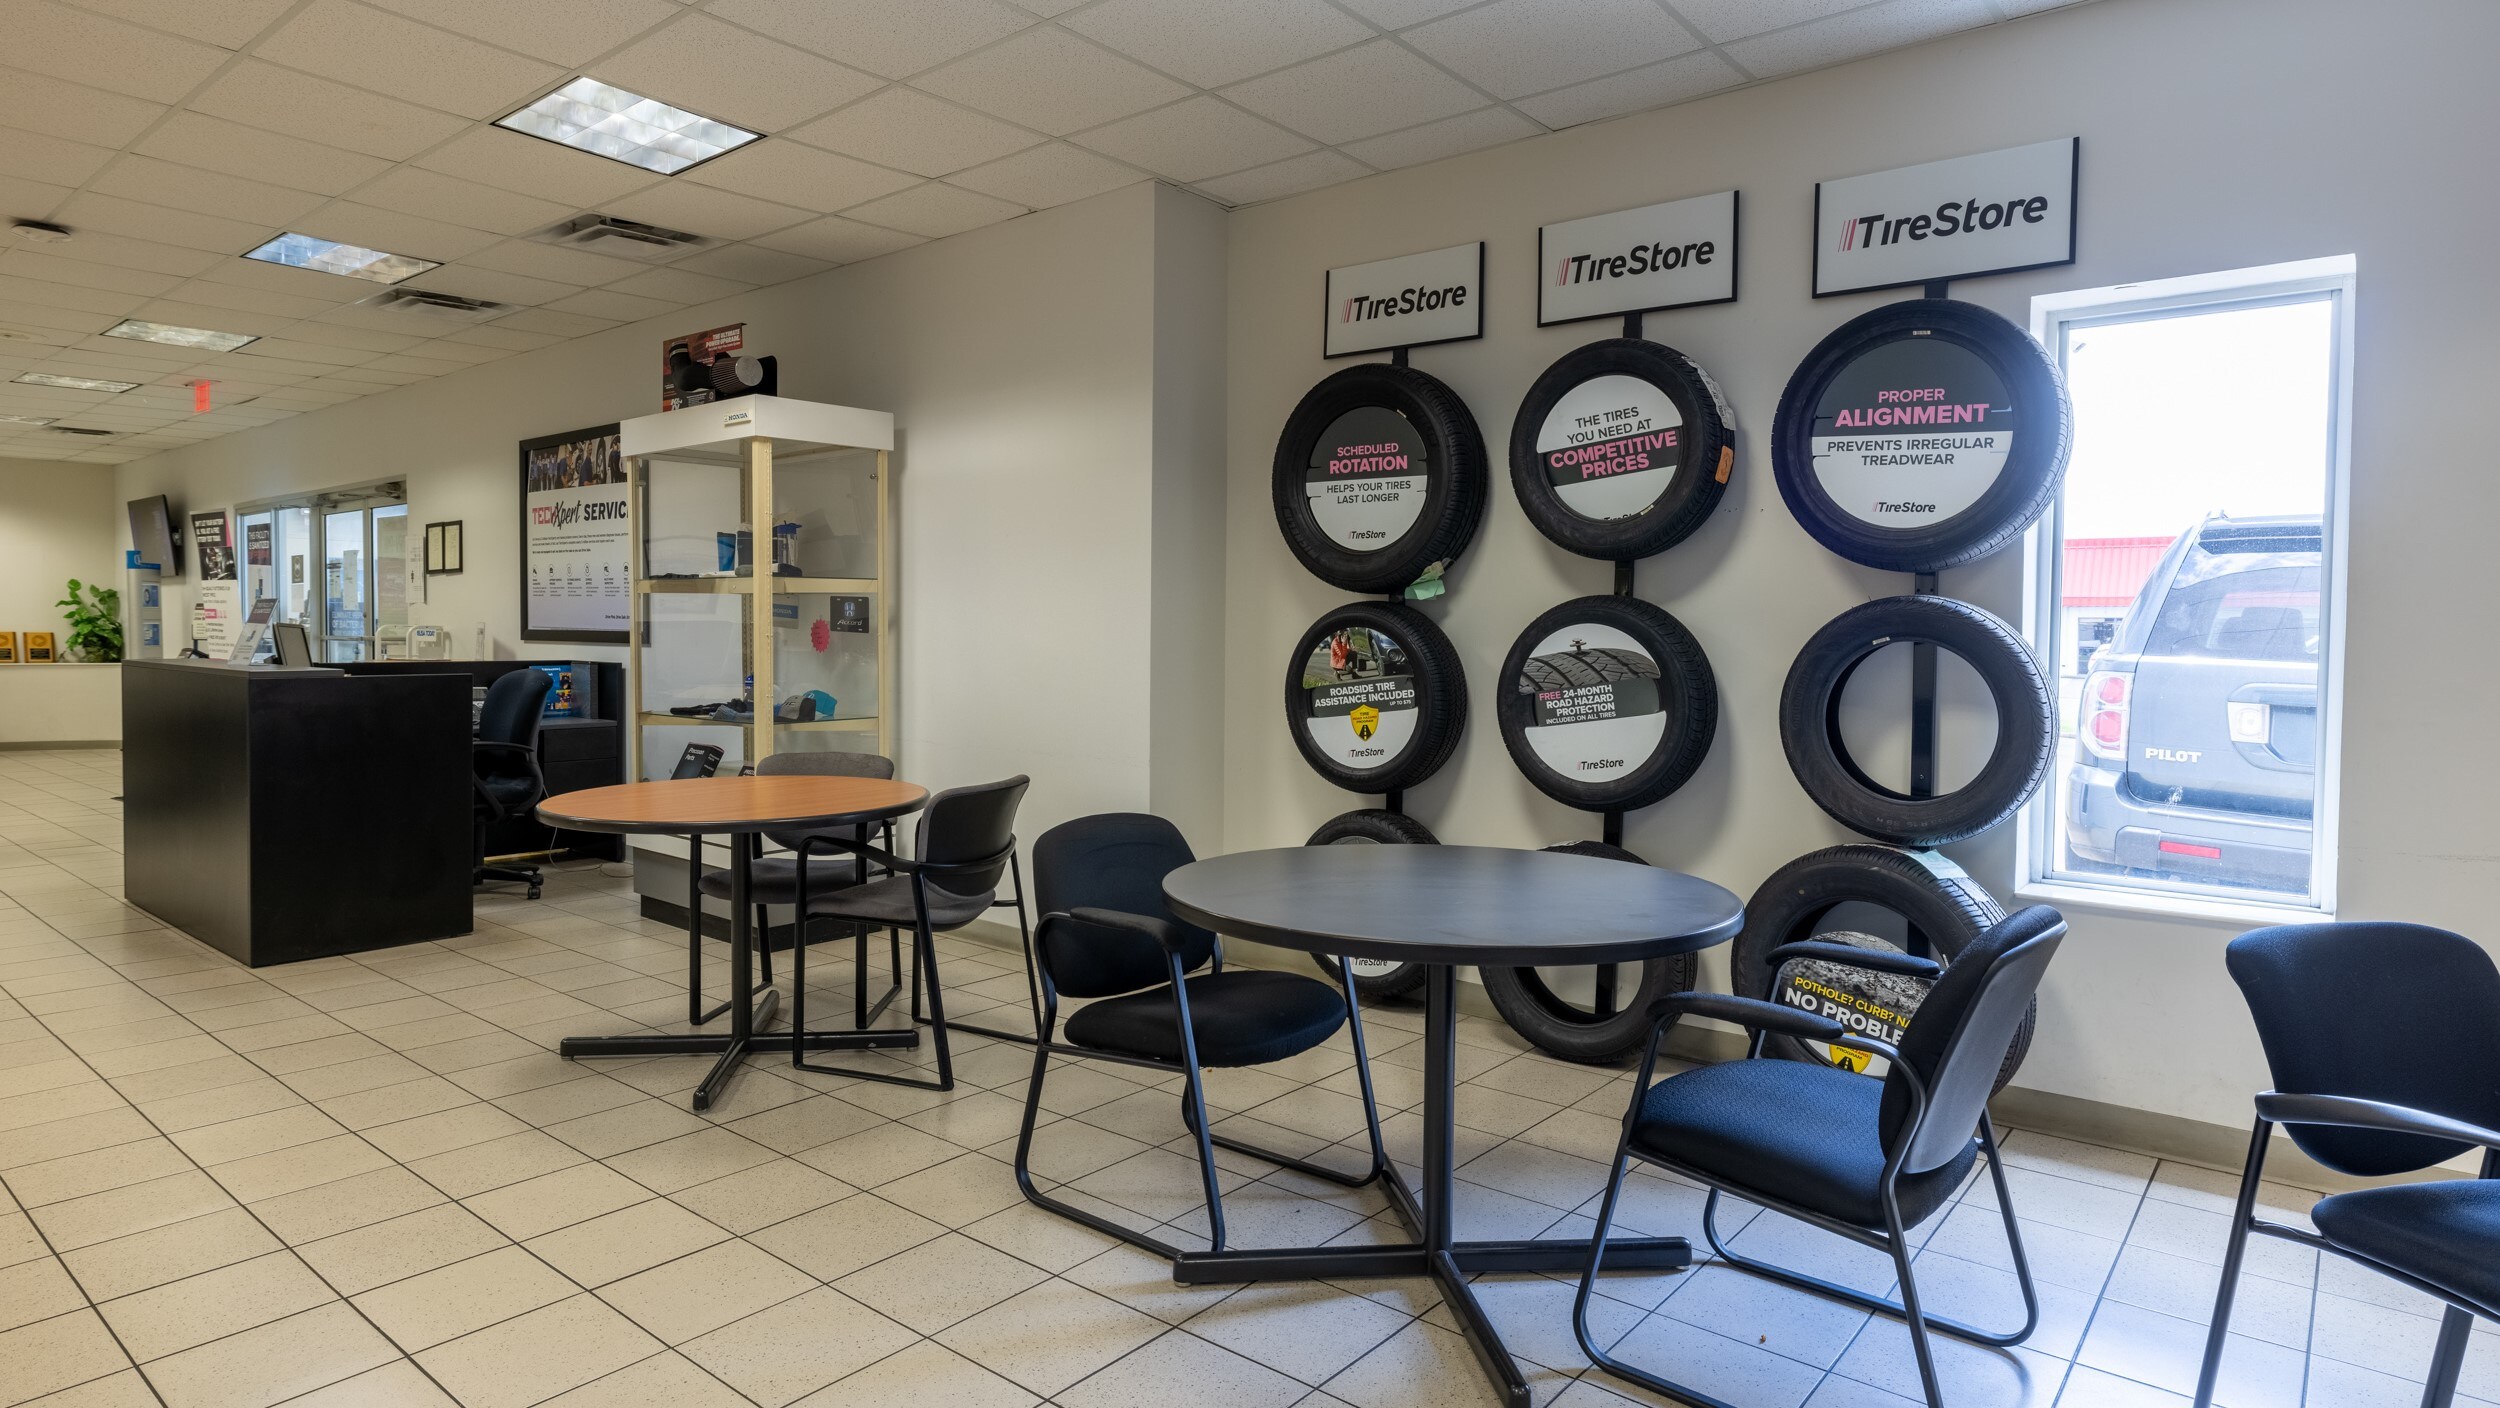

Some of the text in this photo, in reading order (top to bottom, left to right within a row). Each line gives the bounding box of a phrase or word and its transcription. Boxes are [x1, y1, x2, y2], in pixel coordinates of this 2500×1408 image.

[1858, 196, 2048, 249] TireStore
[1571, 241, 1715, 284] TireStore
[1353, 285, 1467, 322] TireStore
[1878, 388, 1945, 403] PROPER
[728, 412, 748, 421] HONDA
[1575, 407, 1640, 429] THE TIRES
[1835, 403, 1990, 428] ALIGNMENT
[1566, 418, 1652, 445] YOU NEED AT
[1337, 443, 1399, 457] SCHEDULED
[1550, 430, 1678, 468] COMPETITIVE
[1827, 437, 1995, 453] PREVENTS IRREGULAR
[1329, 455, 1408, 475] ROTATION
[1581, 453, 1650, 479] PRICES
[1861, 454, 1955, 466] TREADWEAR
[1326, 480, 1412, 494] HELPS YOUR TIRES
[1337, 493, 1400, 504] LAST LONGER
[583, 500, 629, 521] SERVIC
[1878, 501, 1936, 513] TireStore
[1351, 530, 1386, 540] TireStore
[1330, 681, 1396, 697] ROADSIDE TIRE
[1538, 684, 1612, 701] FREE 24-MONTH
[1314, 689, 1415, 708] ASSISTANCE INCLUDED
[1546, 693, 1614, 709] ROAD HAZARD
[1556, 702, 1615, 717] PROTECTION
[1546, 716, 1575, 725] INCLUDED
[1599, 711, 1616, 719] TIRES
[1350, 747, 1385, 758] TireStore
[2145, 747, 2202, 763] PILOT
[1581, 758, 1624, 770] TireStore
[1355, 958, 1387, 967] TireStore
[1794, 977, 1854, 1006] POTHOLE?
[1855, 1000, 1894, 1022] CURB?
[1785, 987, 1904, 1046] NO PROBLE
